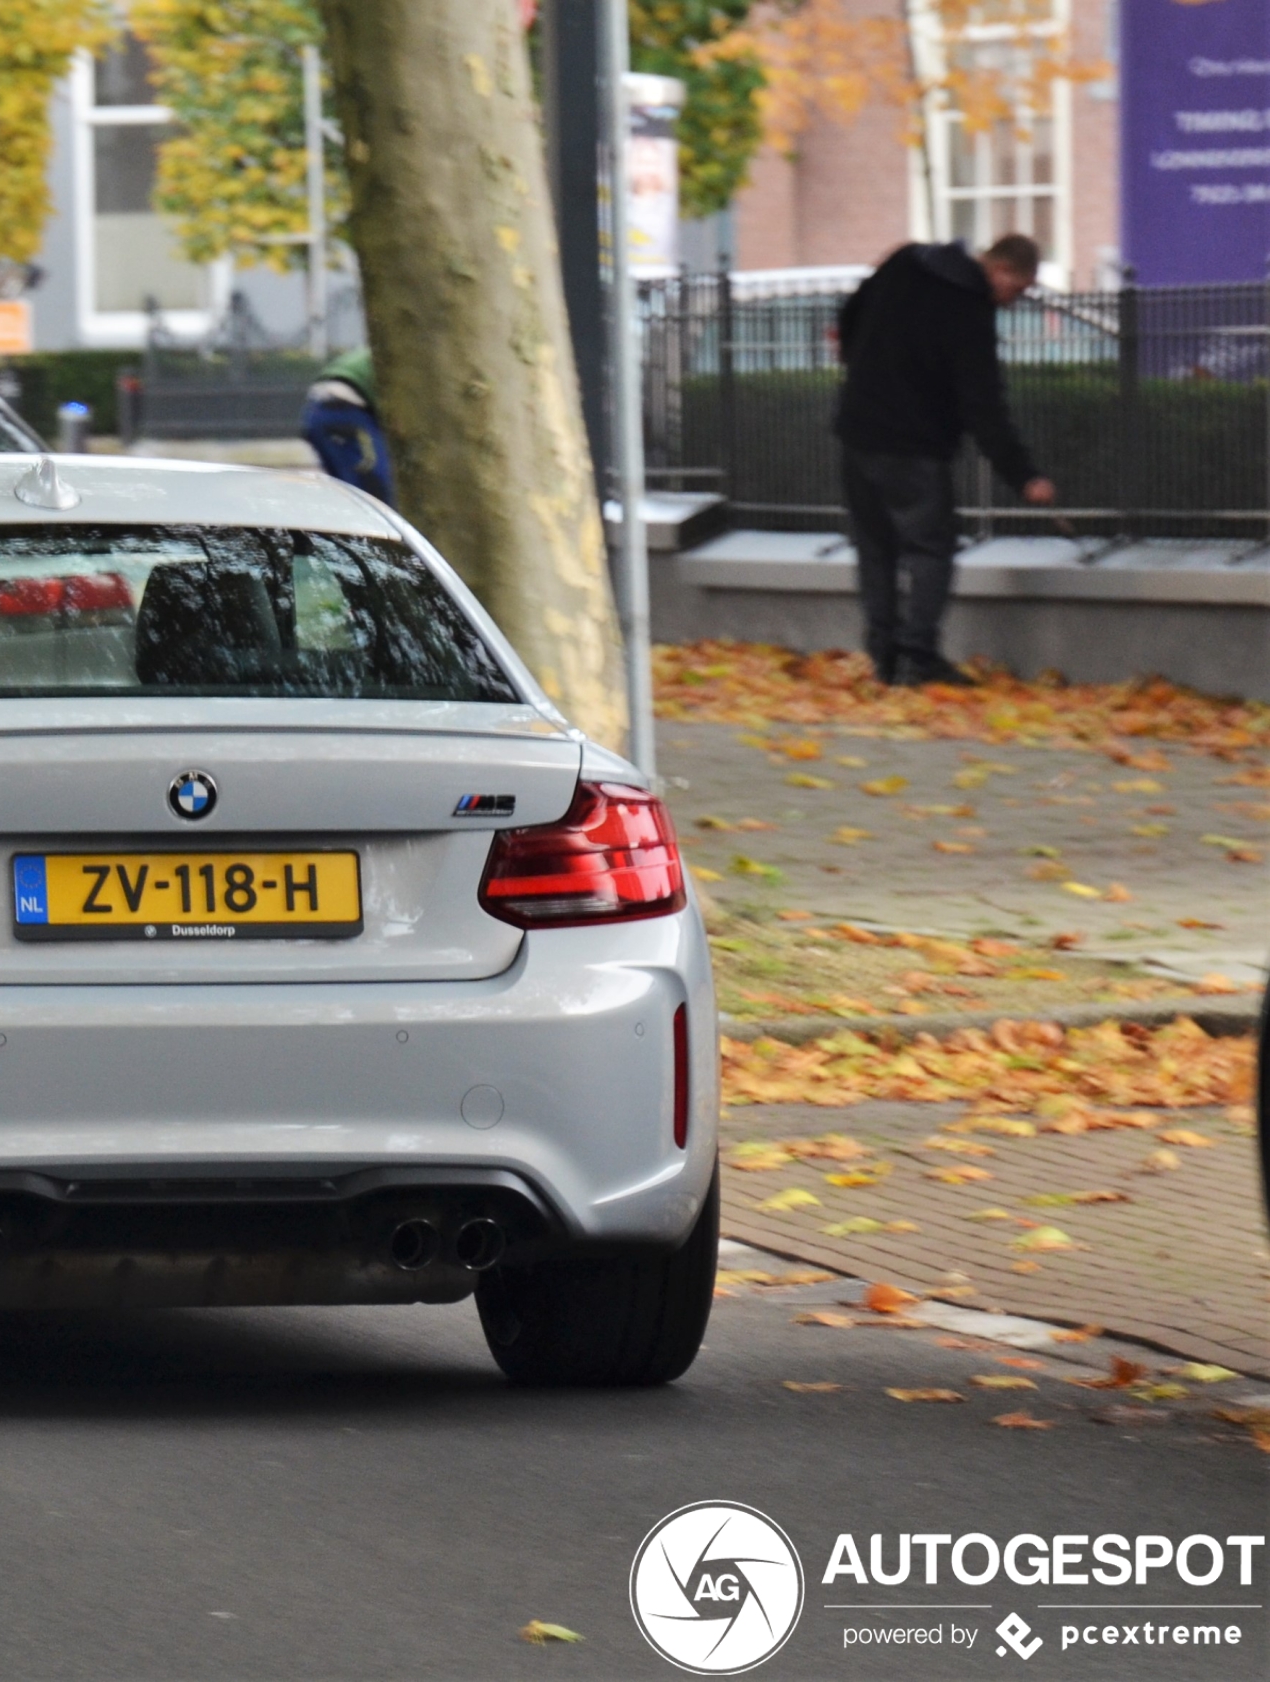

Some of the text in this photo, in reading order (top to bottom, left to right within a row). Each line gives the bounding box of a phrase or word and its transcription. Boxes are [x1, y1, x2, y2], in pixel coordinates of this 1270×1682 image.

[81, 863, 320, 914] ZV-118-H
[20, 896, 43, 913] NL
[172, 924, 236, 938] Dusseldorp
